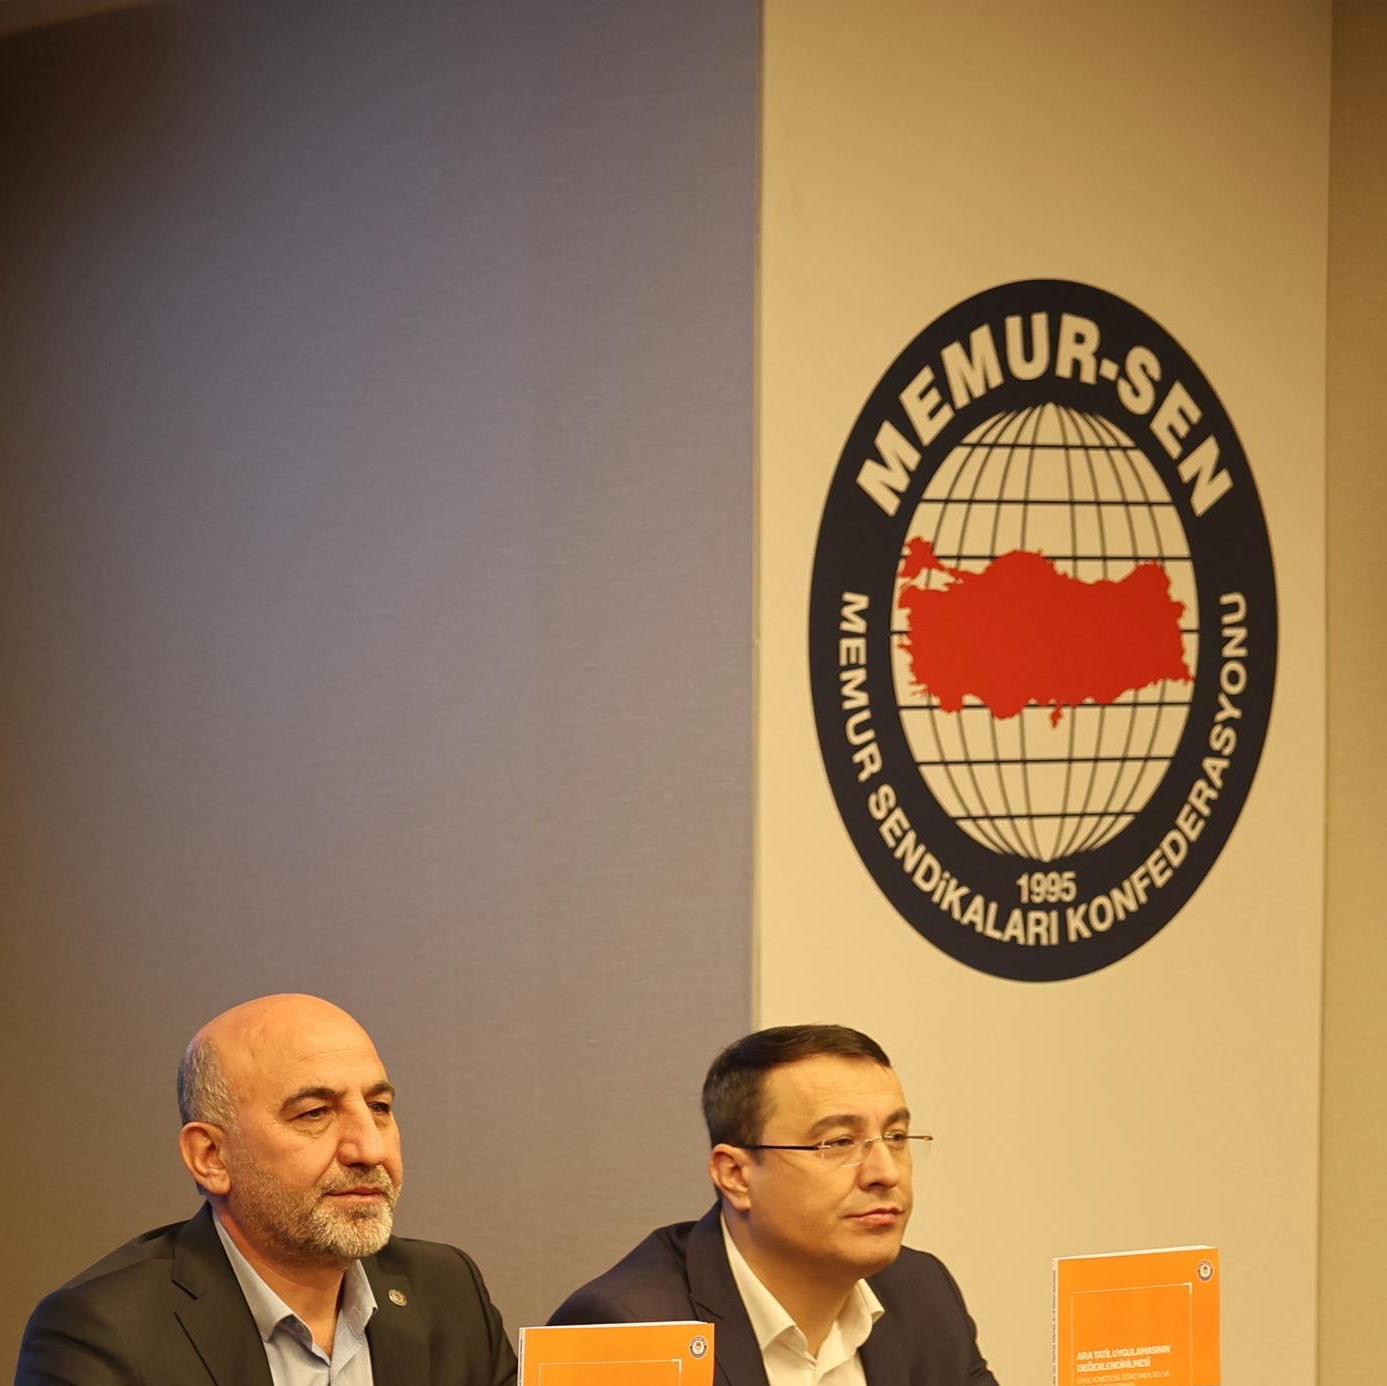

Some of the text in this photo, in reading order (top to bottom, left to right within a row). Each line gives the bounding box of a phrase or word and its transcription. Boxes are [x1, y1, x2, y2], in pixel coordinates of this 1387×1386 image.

[856, 311, 1234, 518] MEMUR-SEN
[838, 591, 882, 782] MEMUR
[1067, 591, 1249, 943] KONFEDERASYONU
[1016, 871, 1077, 902] 1995
